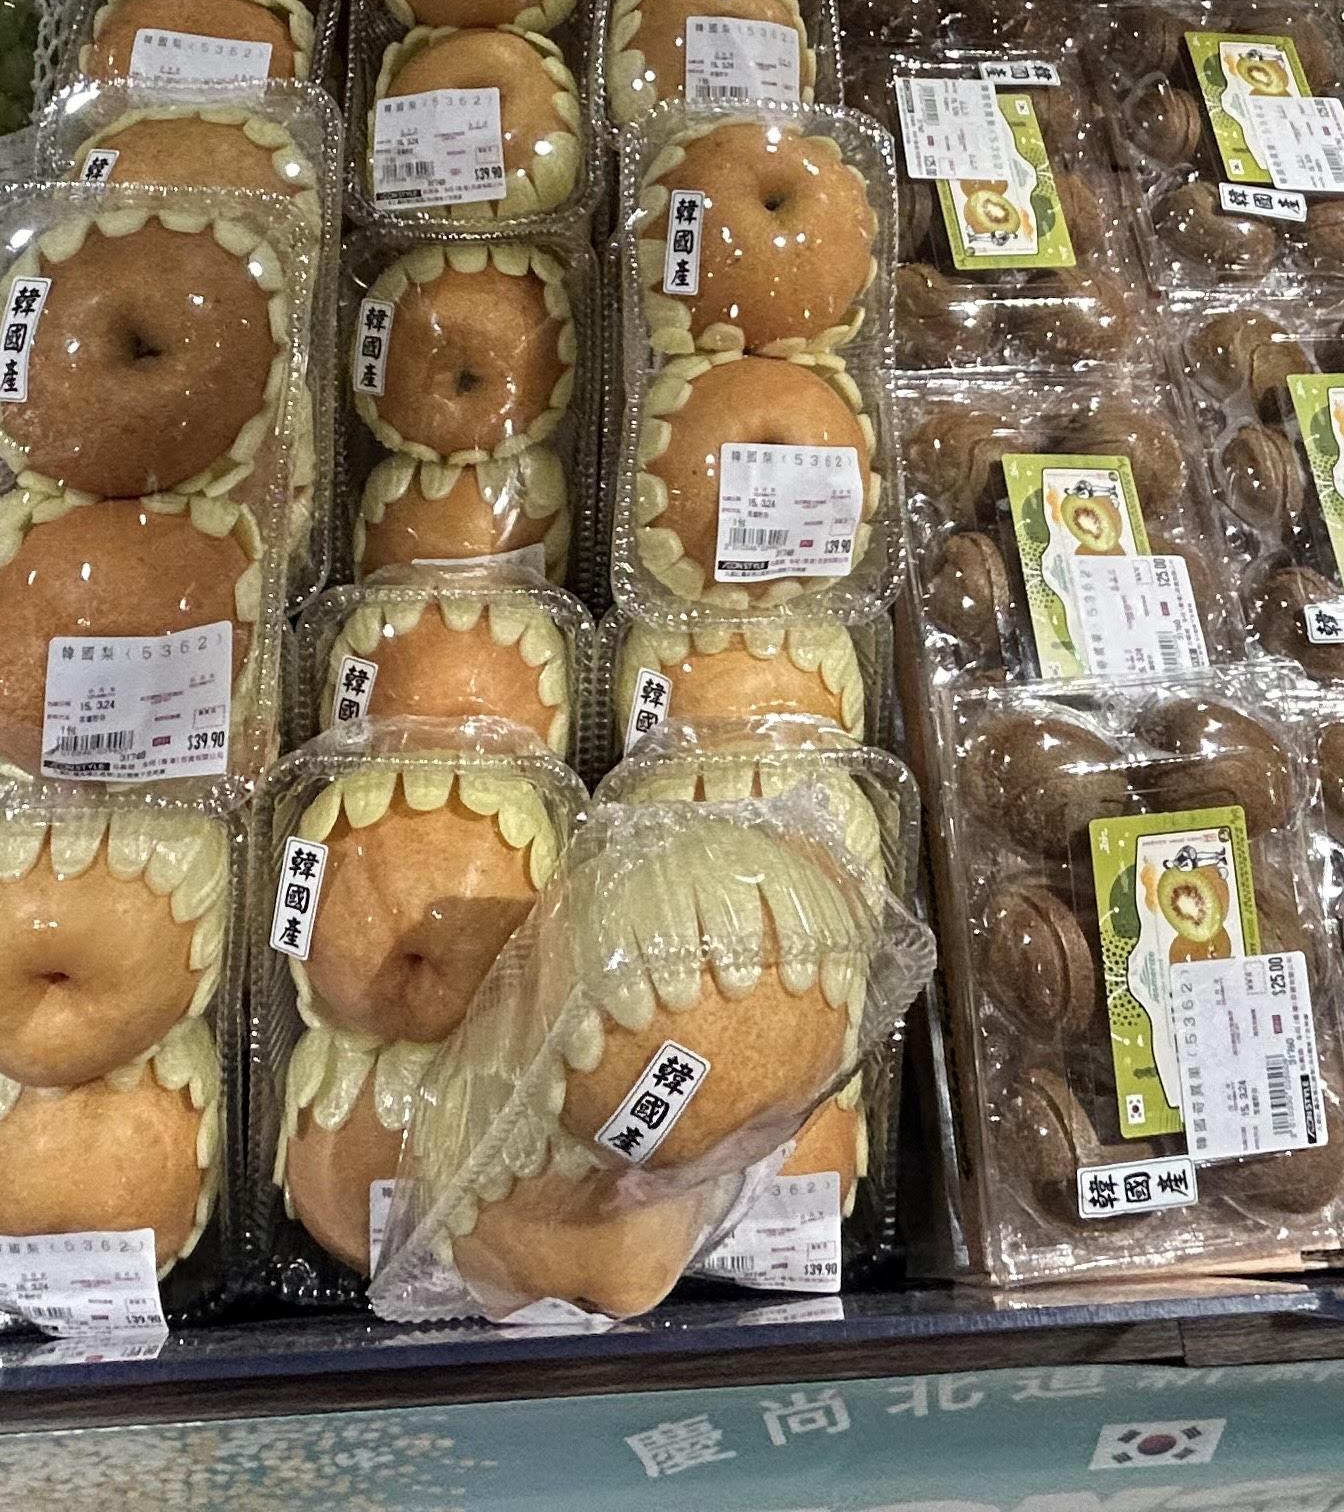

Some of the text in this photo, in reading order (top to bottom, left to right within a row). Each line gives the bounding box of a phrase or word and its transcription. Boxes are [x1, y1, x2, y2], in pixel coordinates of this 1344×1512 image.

[670, 197, 699, 289] 韓國產
[360, 307, 389, 389] 韓國產
[187, 731, 225, 752] $39.90
[278, 848, 321, 949] 韓國產
[1265, 956, 1287, 997] $25.00
[607, 1055, 695, 1158] 韓國產
[1089, 1168, 1190, 1209] 韓國產
[803, 1262, 838, 1277] $39.90
